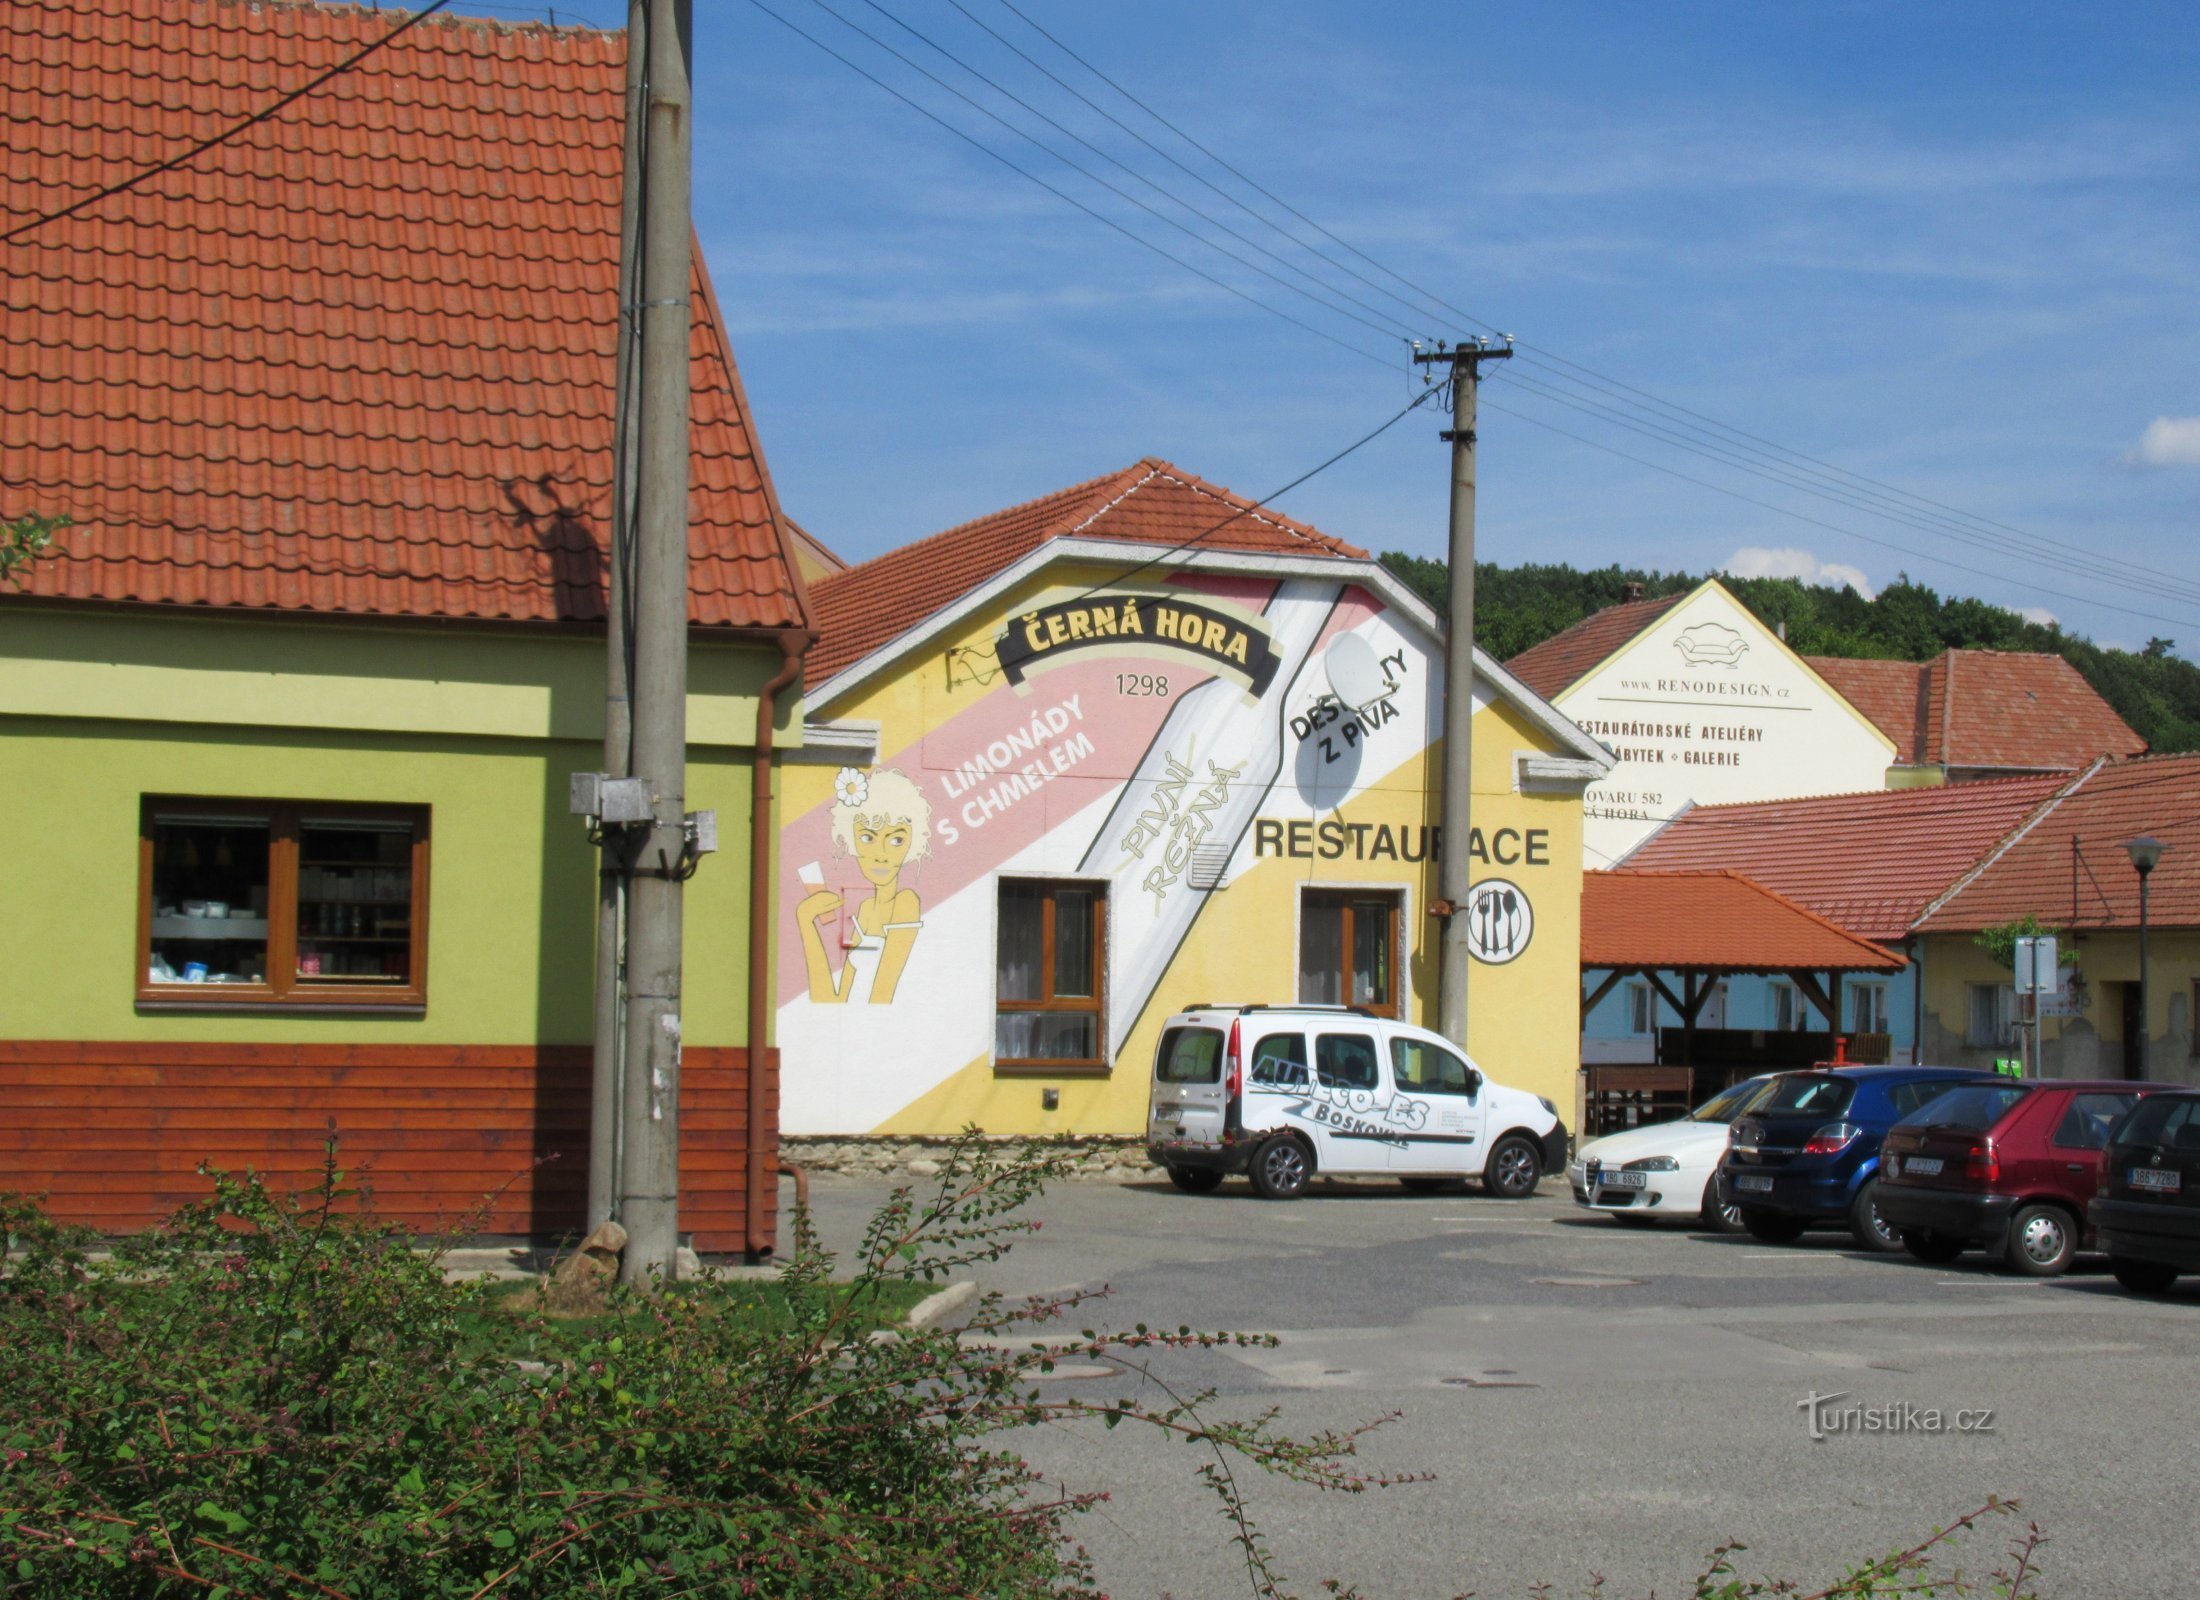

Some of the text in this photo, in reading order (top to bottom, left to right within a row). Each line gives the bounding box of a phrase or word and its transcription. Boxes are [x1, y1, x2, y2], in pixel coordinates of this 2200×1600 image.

[1022, 599, 1248, 664] ČERNÁ HORA
[1115, 673, 1168, 697] 1298
[1289, 648, 1407, 742] DESTY
[941, 694, 1084, 799] LIMONÁDY
[1317, 699, 1400, 764] Z PIVA
[1577, 719, 1763, 742] ESTAURÁTORSKÉ ATELIÉRY
[1615, 745, 1740, 766] ÁBYTEK GALERIE
[937, 732, 1096, 846] S CHMELEM
[1121, 750, 1194, 860] PIVNÍ
[1586, 790, 1663, 805] OVARU 582
[1605, 808, 1648, 820] HORA
